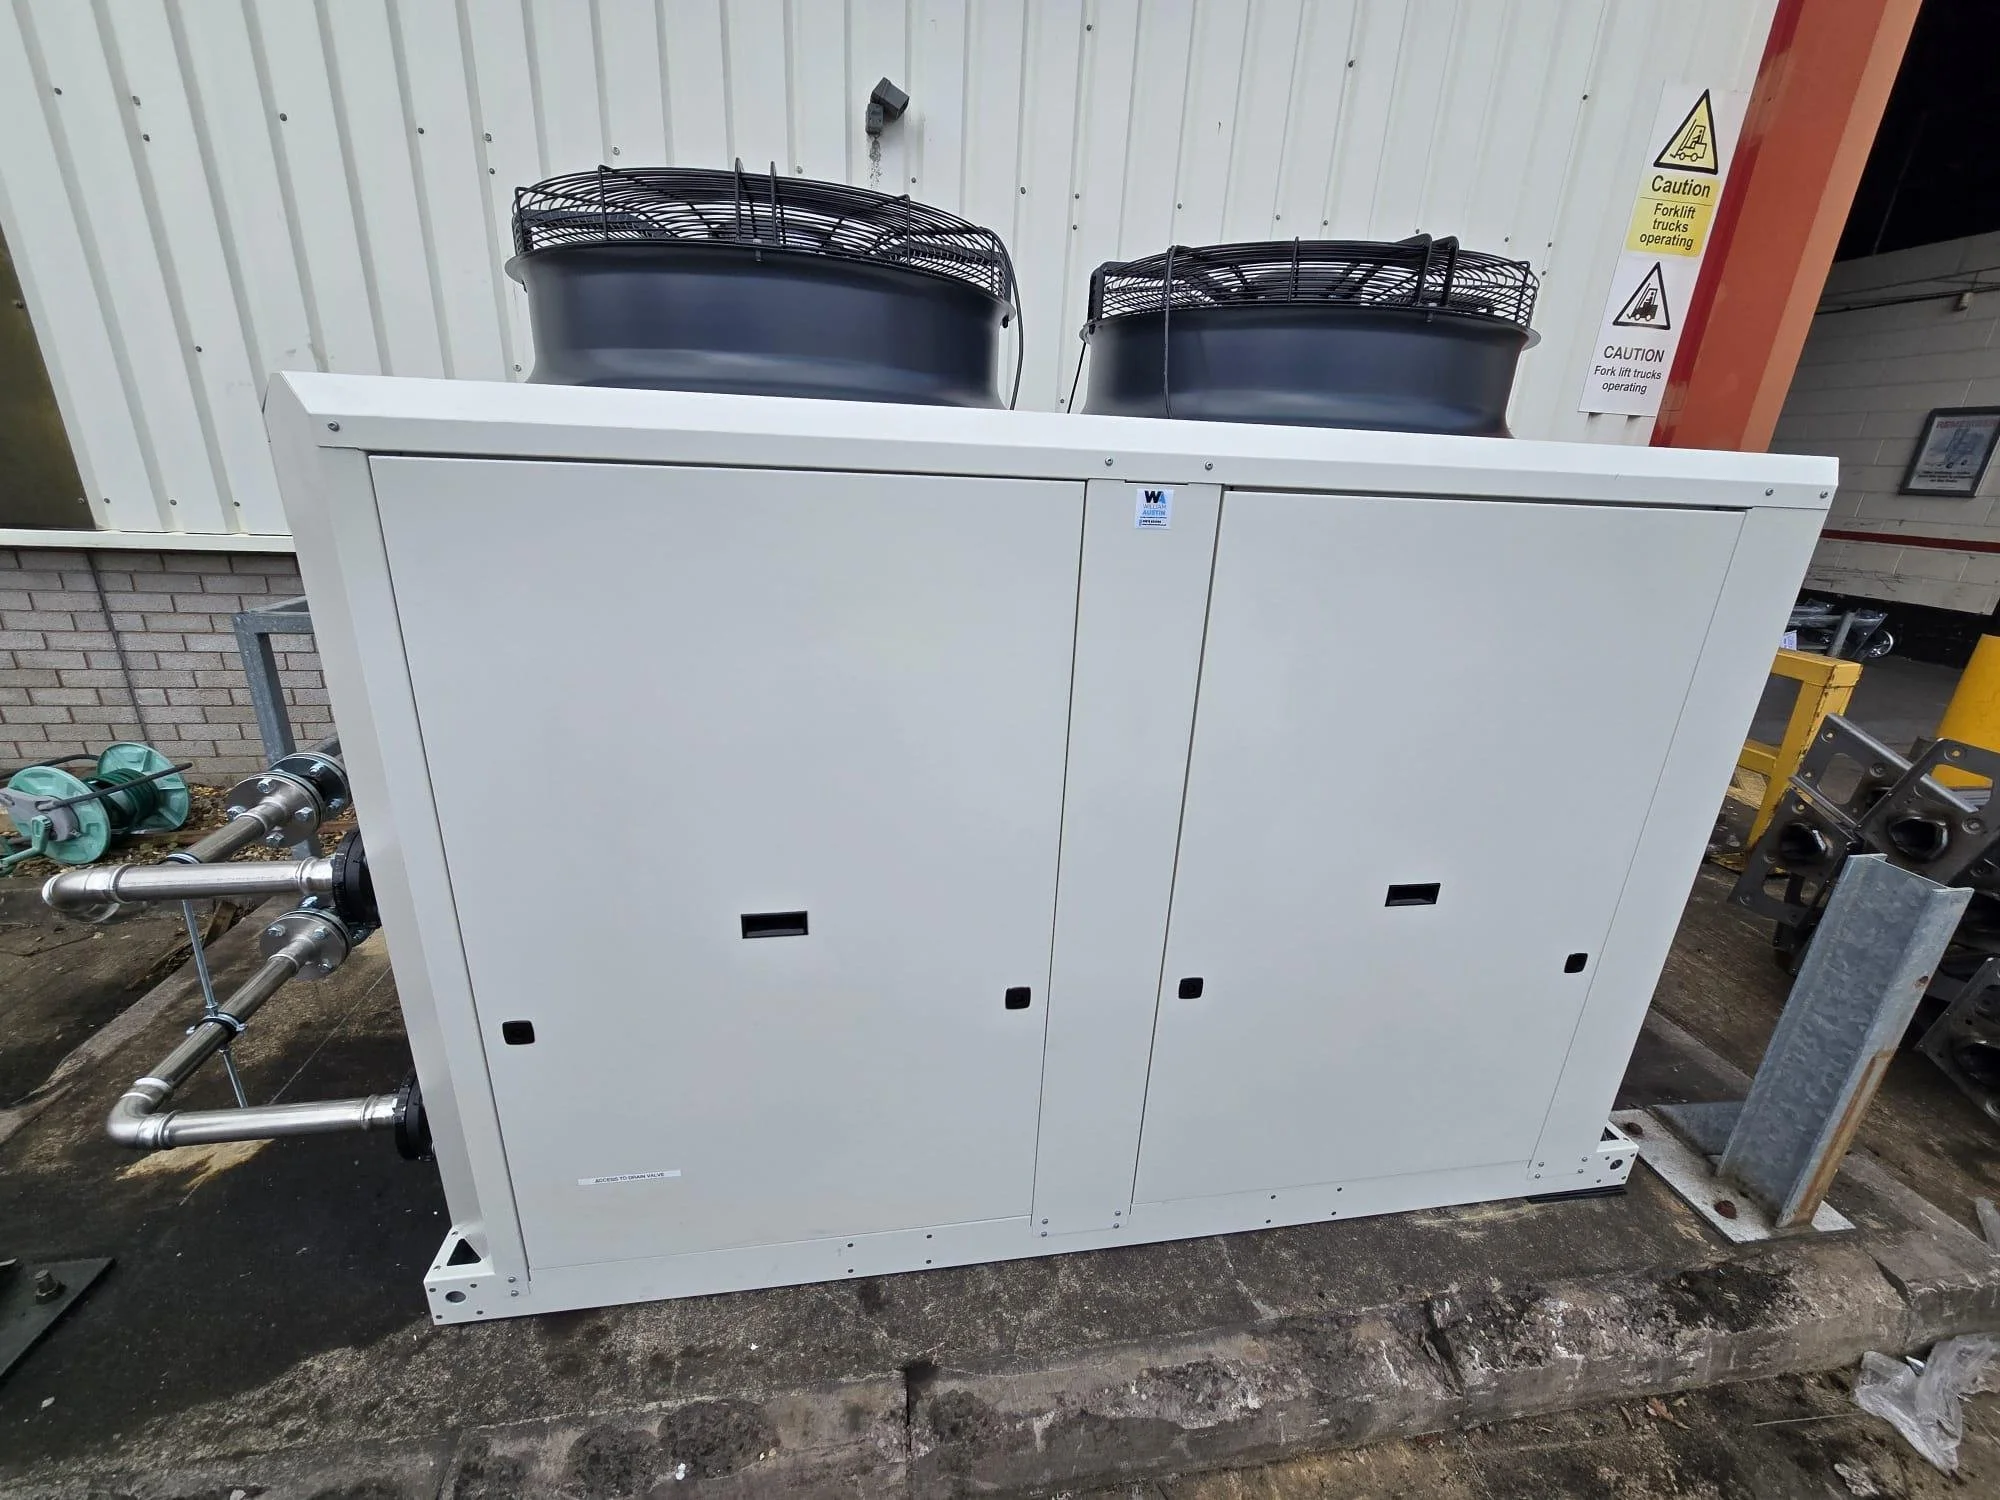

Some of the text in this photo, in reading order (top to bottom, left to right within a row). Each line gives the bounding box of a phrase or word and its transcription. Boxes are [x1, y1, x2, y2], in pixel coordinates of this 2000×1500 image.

[1651, 174, 1711, 199] Caution
[1653, 202, 1696, 220] Forklift
[1652, 218, 1689, 233] trucks
[1639, 232, 1694, 251] operating
[1603, 345, 1665, 363] CAUTION
[1594, 365, 1662, 380] Fork lift trucks
[1602, 381, 1648, 395] operating
[1144, 490, 1166, 504] WA
